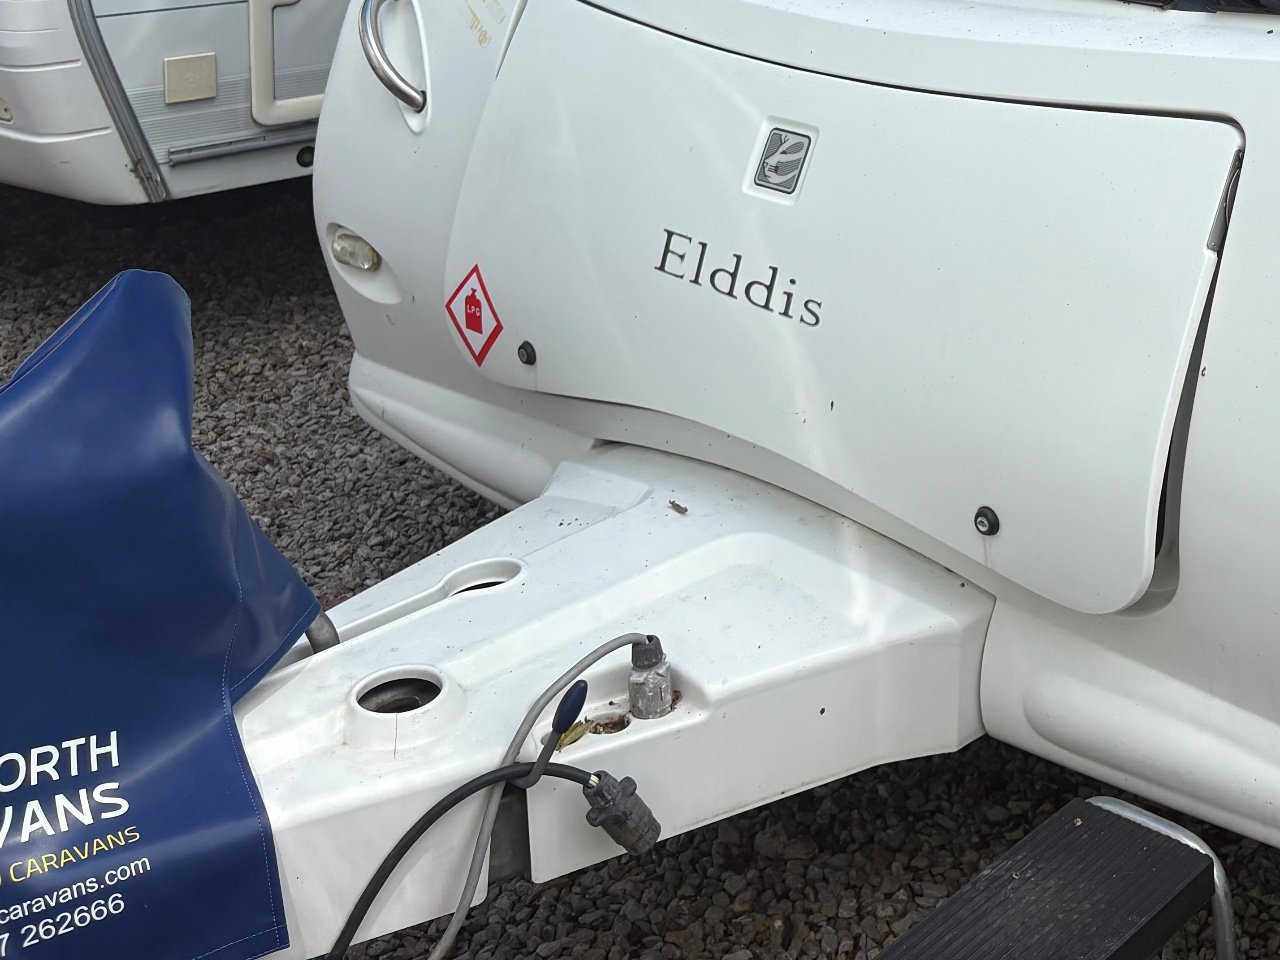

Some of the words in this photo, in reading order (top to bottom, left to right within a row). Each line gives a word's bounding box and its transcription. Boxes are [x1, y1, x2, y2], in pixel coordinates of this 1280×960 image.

[653, 227, 824, 328] Elddis
[466, 303, 481, 317] LPG
[0, 730, 120, 793] ORTH
[9, 825, 141, 882] CARAVANS
[0, 857, 151, 925] caravans.com
[20, 893, 126, 948] 262666
